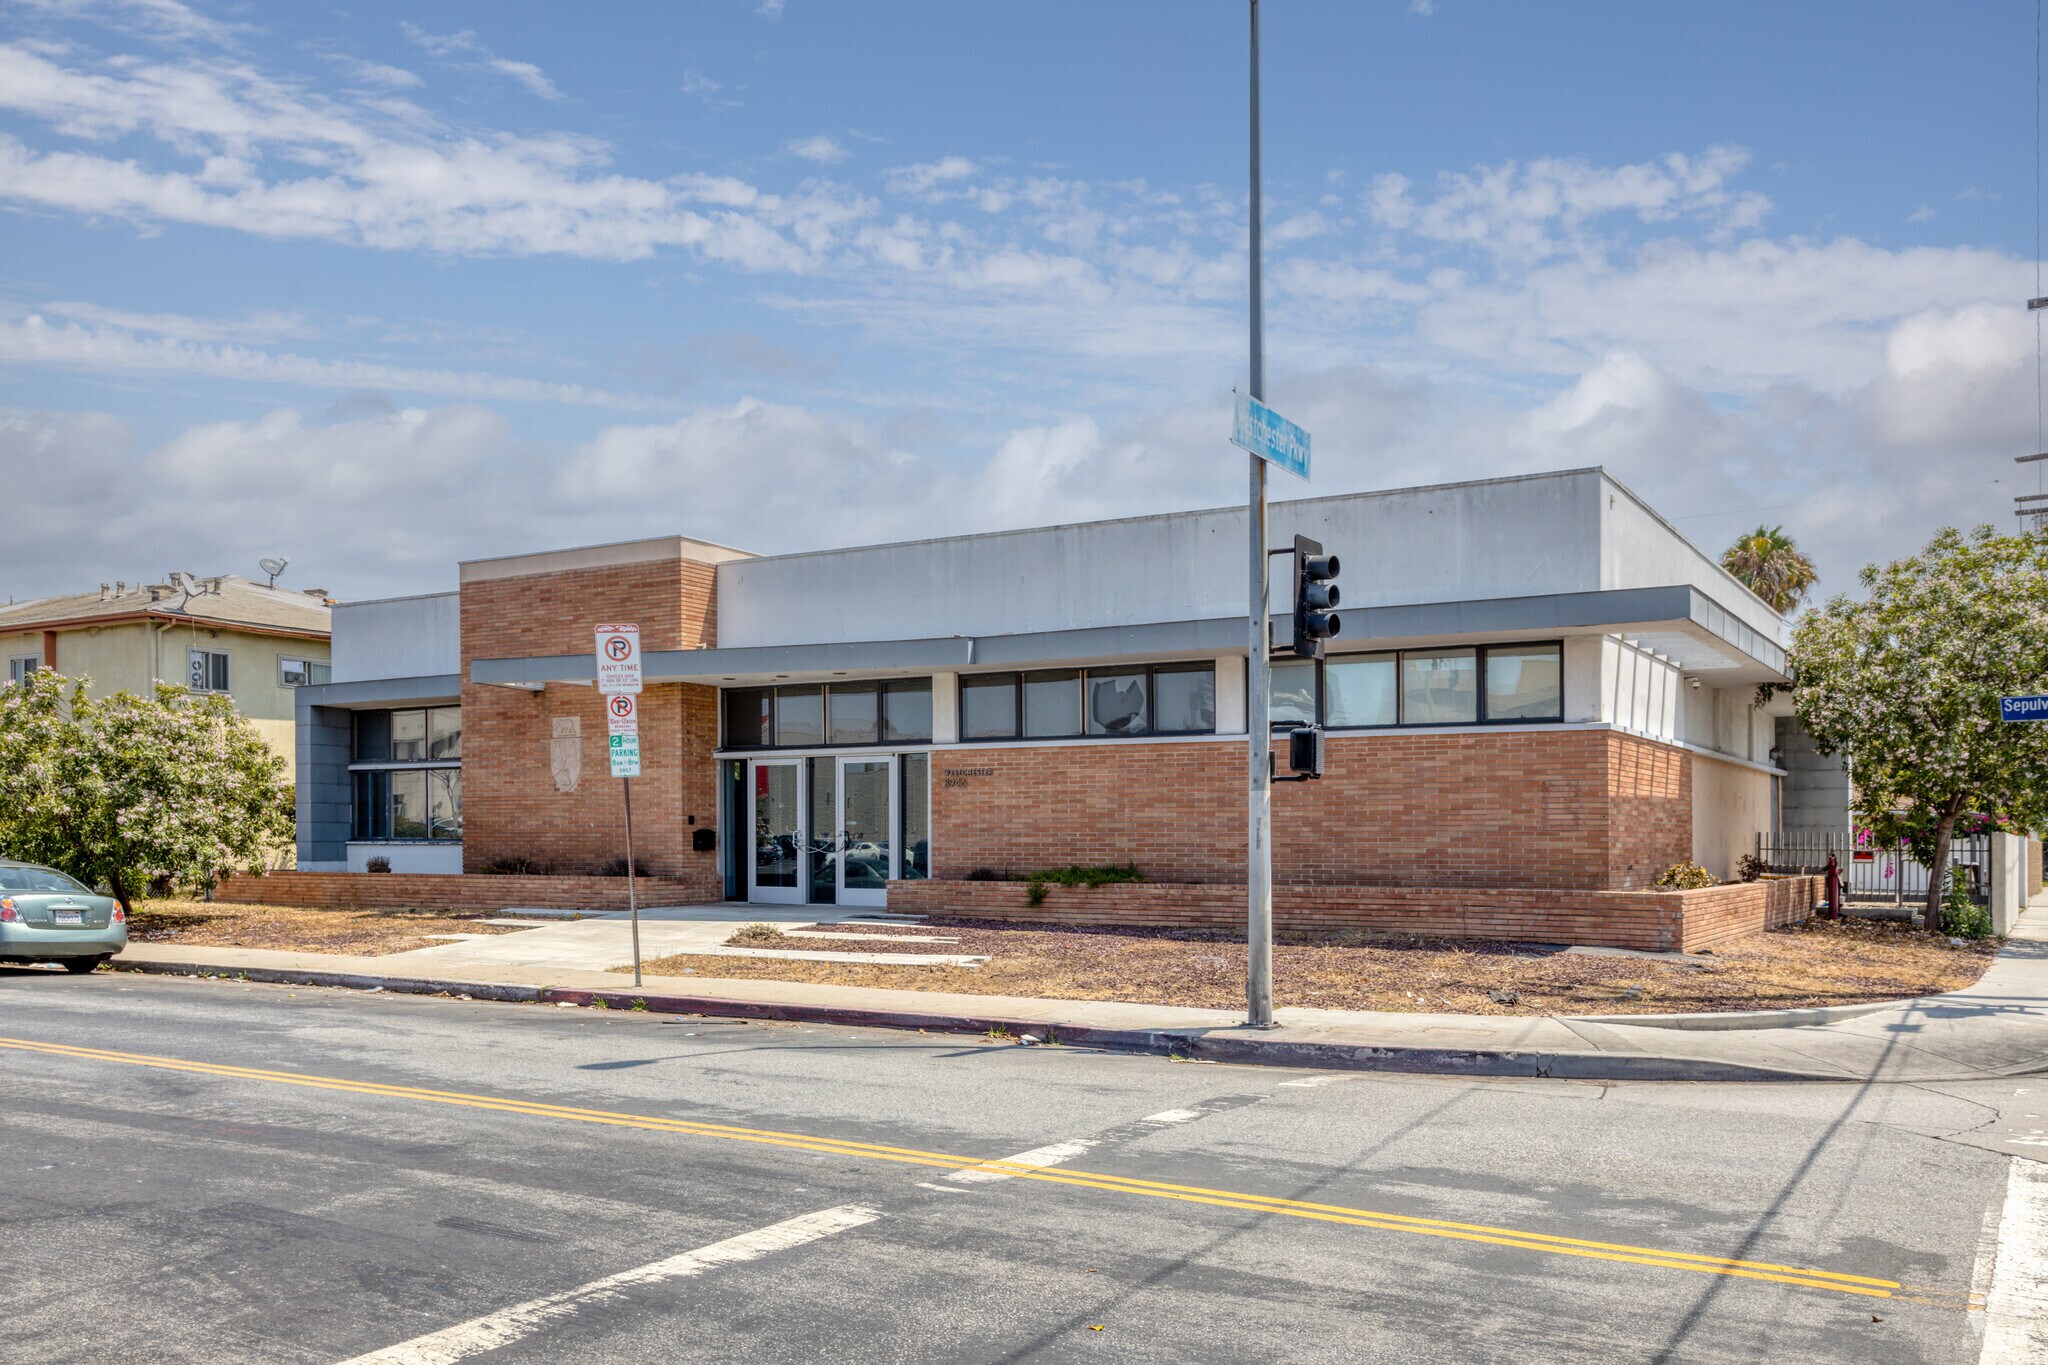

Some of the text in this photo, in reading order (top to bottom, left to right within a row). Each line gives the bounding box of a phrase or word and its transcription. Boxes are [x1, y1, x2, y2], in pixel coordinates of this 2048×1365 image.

[1239, 405, 1286, 455] stchester
[620, 664, 638, 672] TIME
[612, 737, 620, 746] 2
[611, 749, 638, 757] PARKING
